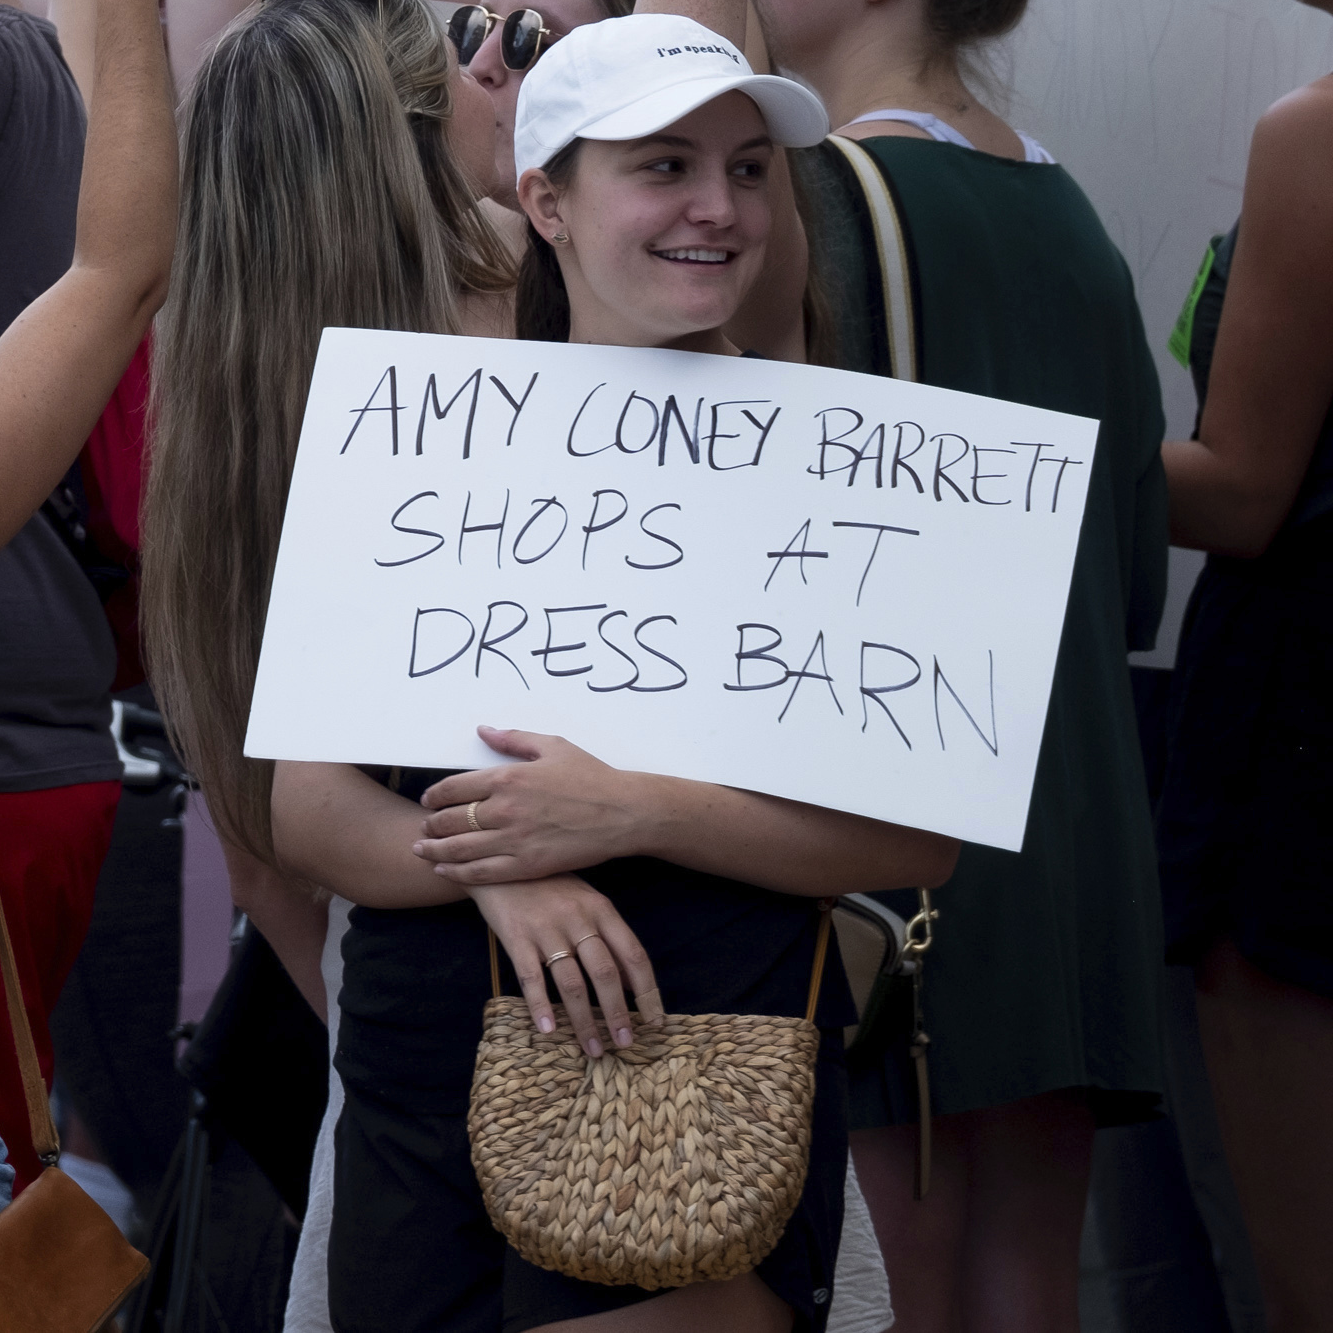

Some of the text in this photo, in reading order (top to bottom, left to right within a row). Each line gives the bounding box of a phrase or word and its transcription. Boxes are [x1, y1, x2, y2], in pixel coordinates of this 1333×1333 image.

[340, 366, 1084, 515] AMY CONEY BARRETT
[375, 489, 919, 606] SHOPS AT
[409, 601, 997, 756] DRESS BARN
